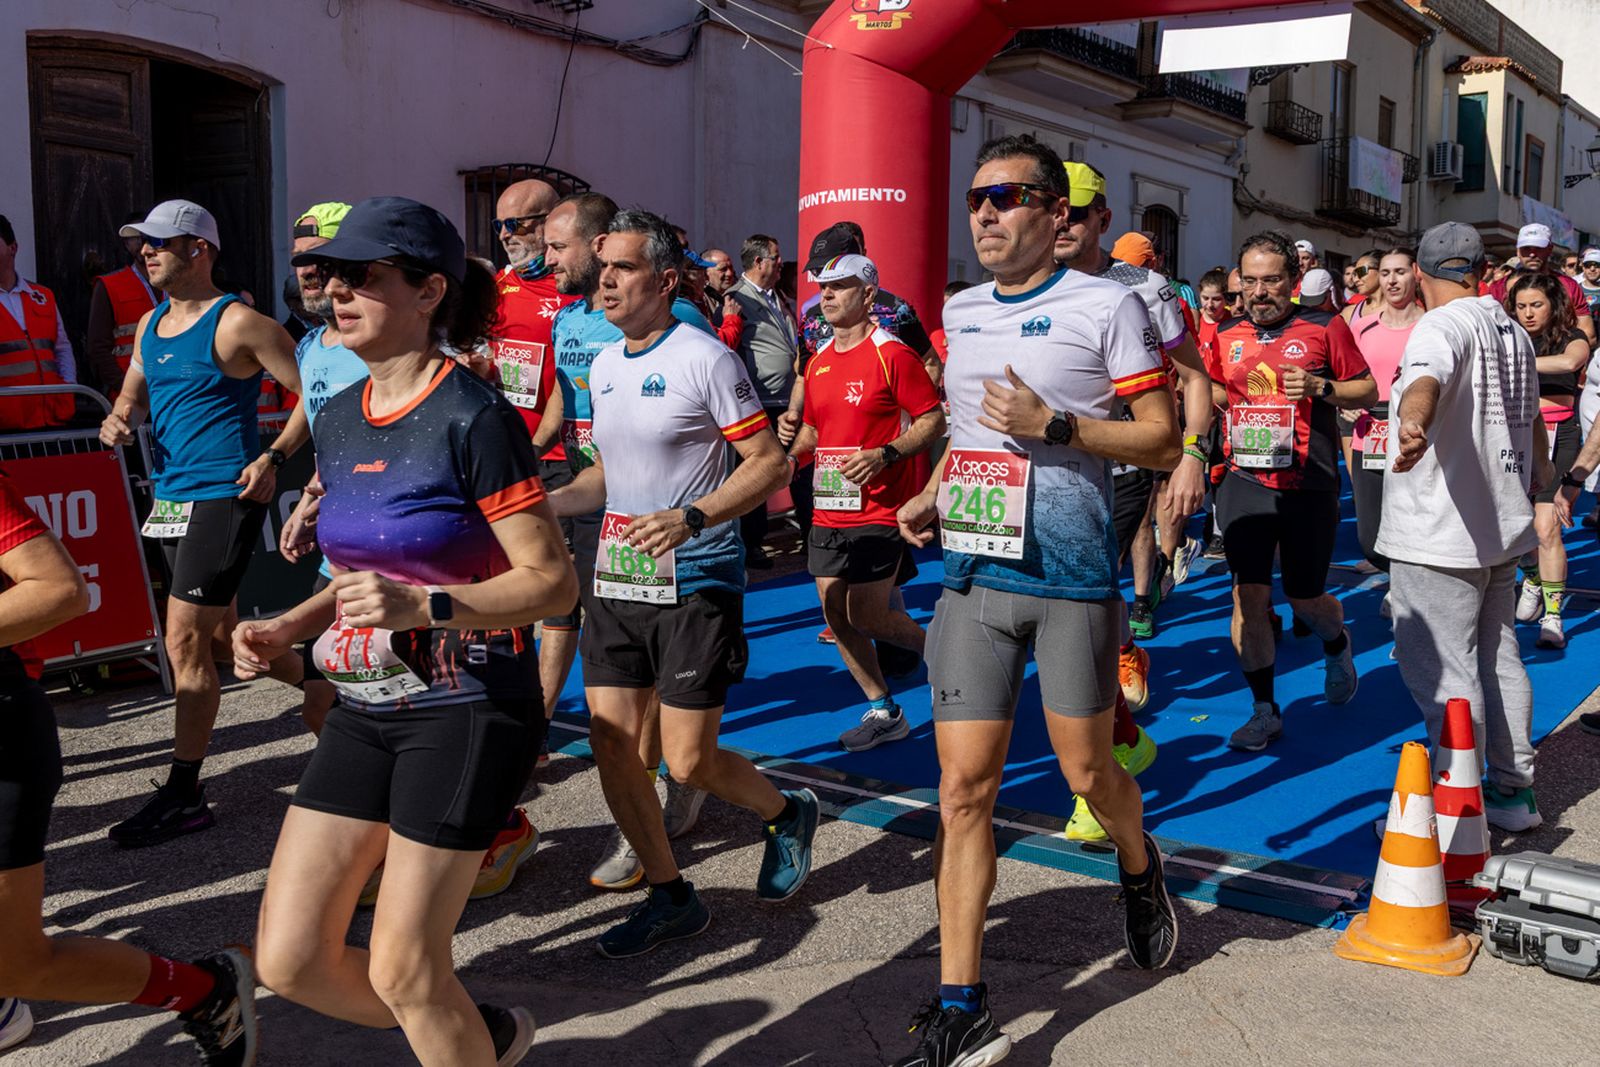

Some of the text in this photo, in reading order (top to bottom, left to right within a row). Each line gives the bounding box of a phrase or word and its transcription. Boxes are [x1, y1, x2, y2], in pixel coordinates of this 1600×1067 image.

[865, 20, 892, 28] MARTOS
[504, 347, 532, 359] CROSS
[502, 362, 520, 385] 81
[1247, 412, 1281, 422] CROSS
[1244, 428, 1272, 449] 89
[950, 454, 1009, 477] X CROSS
[821, 469, 843, 490] 48
[949, 474, 996, 489] PANTANO
[947, 484, 1007, 524] 246
[607, 517, 616, 534] X
